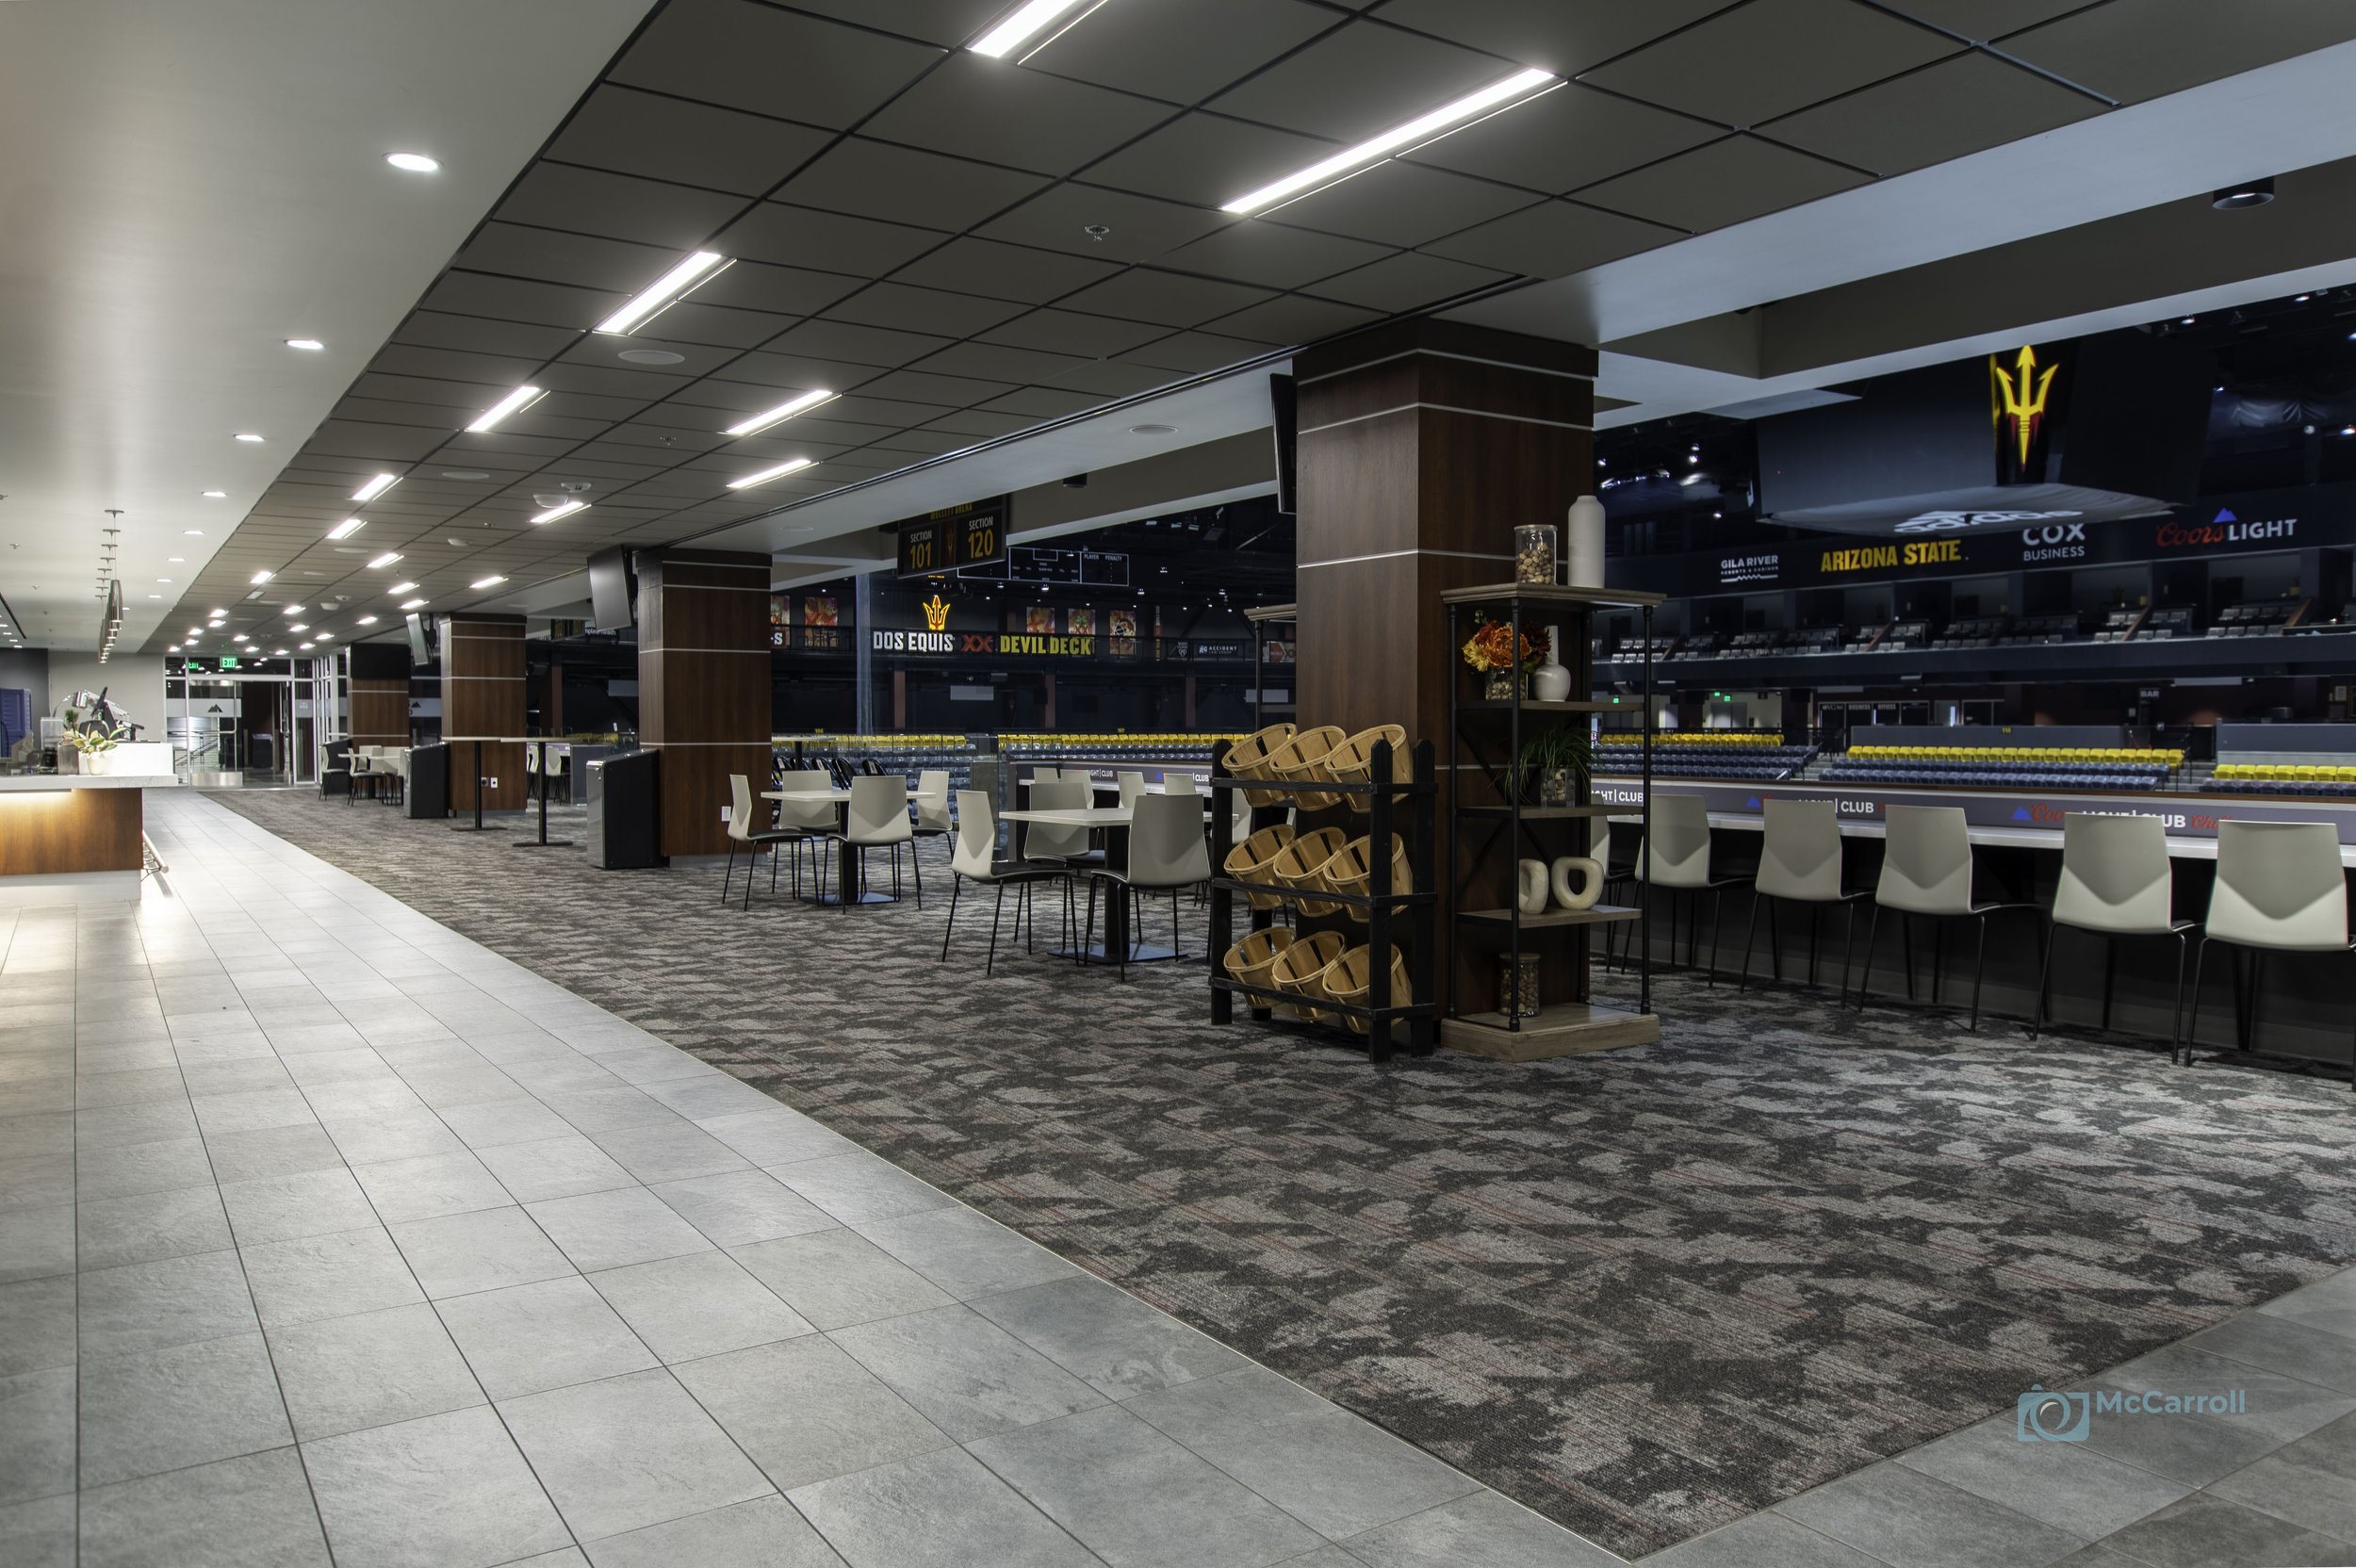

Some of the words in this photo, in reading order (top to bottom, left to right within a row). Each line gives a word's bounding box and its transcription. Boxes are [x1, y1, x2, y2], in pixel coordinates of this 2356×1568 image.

[969, 515, 993, 530] SECTION
[910, 530, 932, 543] SECTION
[2023, 524, 2086, 546] COX
[2156, 522, 2225, 547] Coors
[2229, 519, 2298, 541] LIGHT
[968, 529, 993, 559] 120
[910, 542, 931, 570] 101
[1721, 558, 1745, 569] GILA
[1746, 554, 1778, 566] RIVER
[1821, 546, 1898, 572] ARIZONA
[1904, 540, 1962, 564] STATE
[2023, 546, 2085, 562] BUSINESS
[874, 631, 904, 650] DOS
[908, 632, 954, 652] EQUIS
[961, 634, 992, 653] XX
[1000, 635, 1046, 654] DEVIL
[1050, 637, 1091, 655] DECK
[1618, 792, 1644, 803] CLUB
[1841, 801, 1874, 814] CLUB
